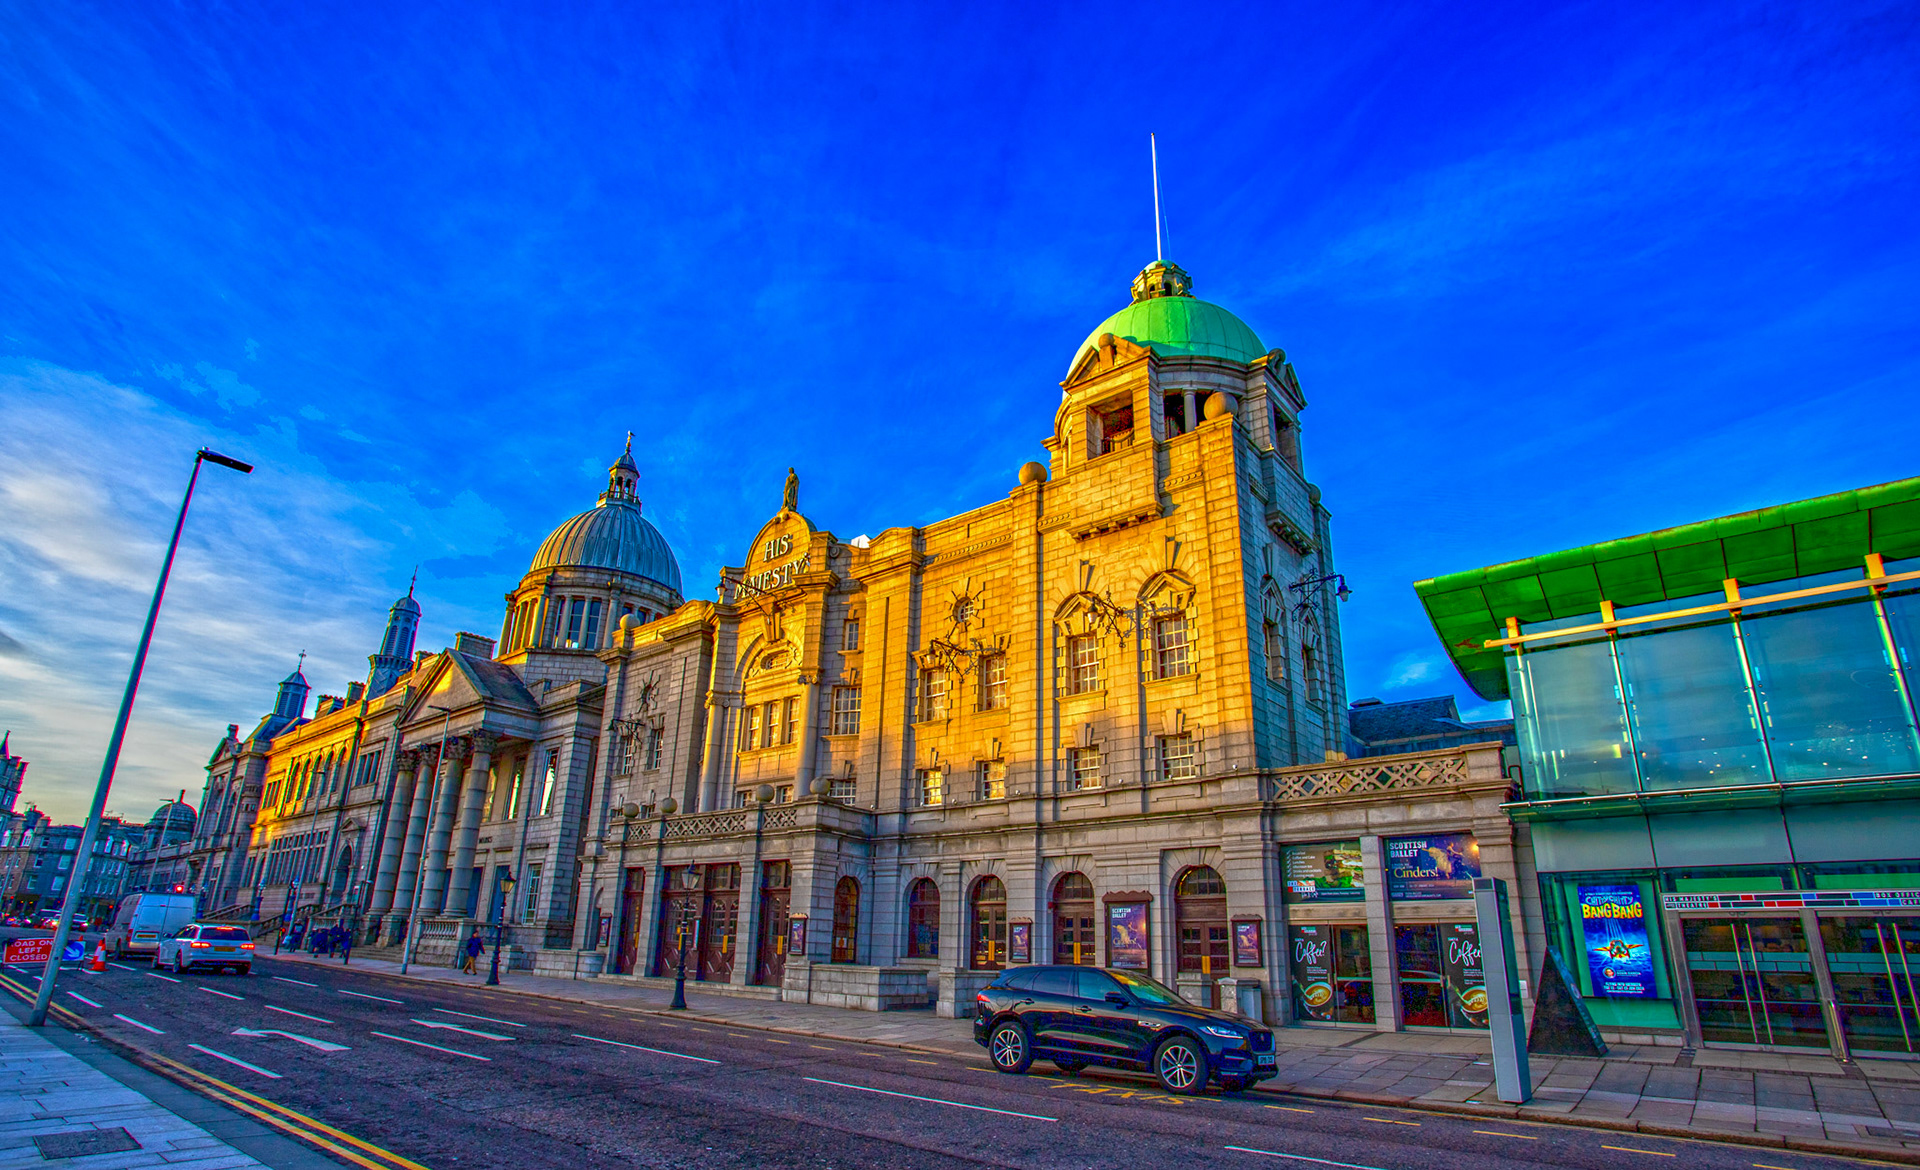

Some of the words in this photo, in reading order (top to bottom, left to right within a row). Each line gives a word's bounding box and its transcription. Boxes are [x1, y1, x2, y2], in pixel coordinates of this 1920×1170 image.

[763, 533, 790, 562] HIS
[1390, 841, 1428, 849] SCOTTISH
[1390, 849, 1418, 858] BALLET
[1394, 866, 1439, 879] Cinders!
[1581, 902, 1612, 919] BANG
[1611, 901, 1643, 919] BANG
[18, 946, 42, 954] LEFT
